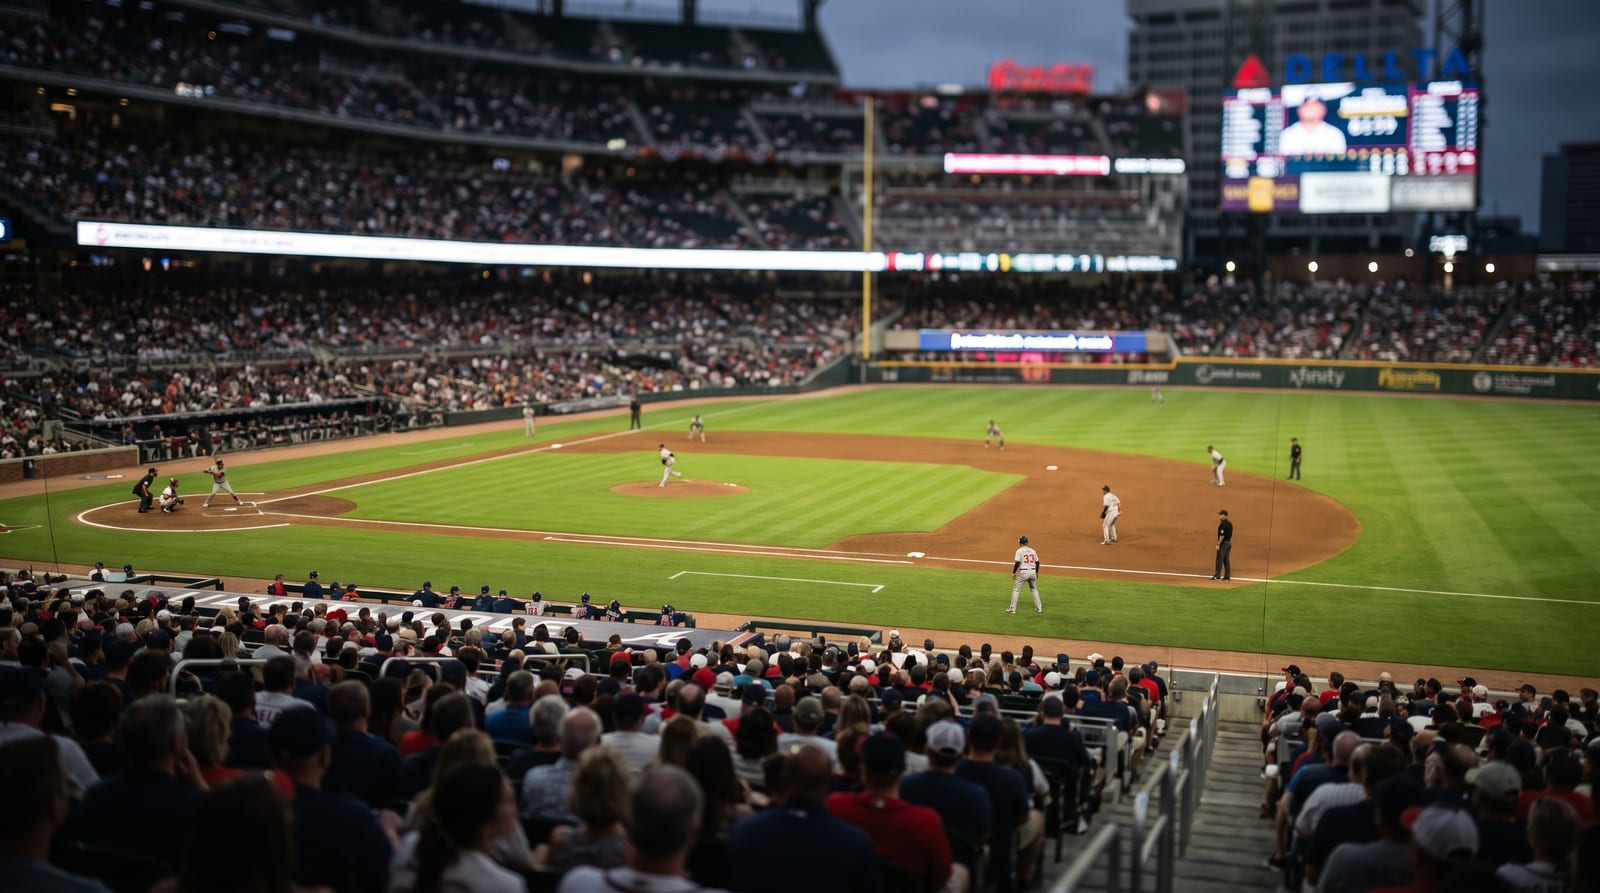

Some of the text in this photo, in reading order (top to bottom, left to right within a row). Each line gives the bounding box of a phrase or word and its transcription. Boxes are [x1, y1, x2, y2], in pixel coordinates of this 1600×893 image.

[1285, 48, 1470, 82] DELLTA
[1289, 366, 1345, 388] xfinity
[1023, 554, 1035, 564] 33
